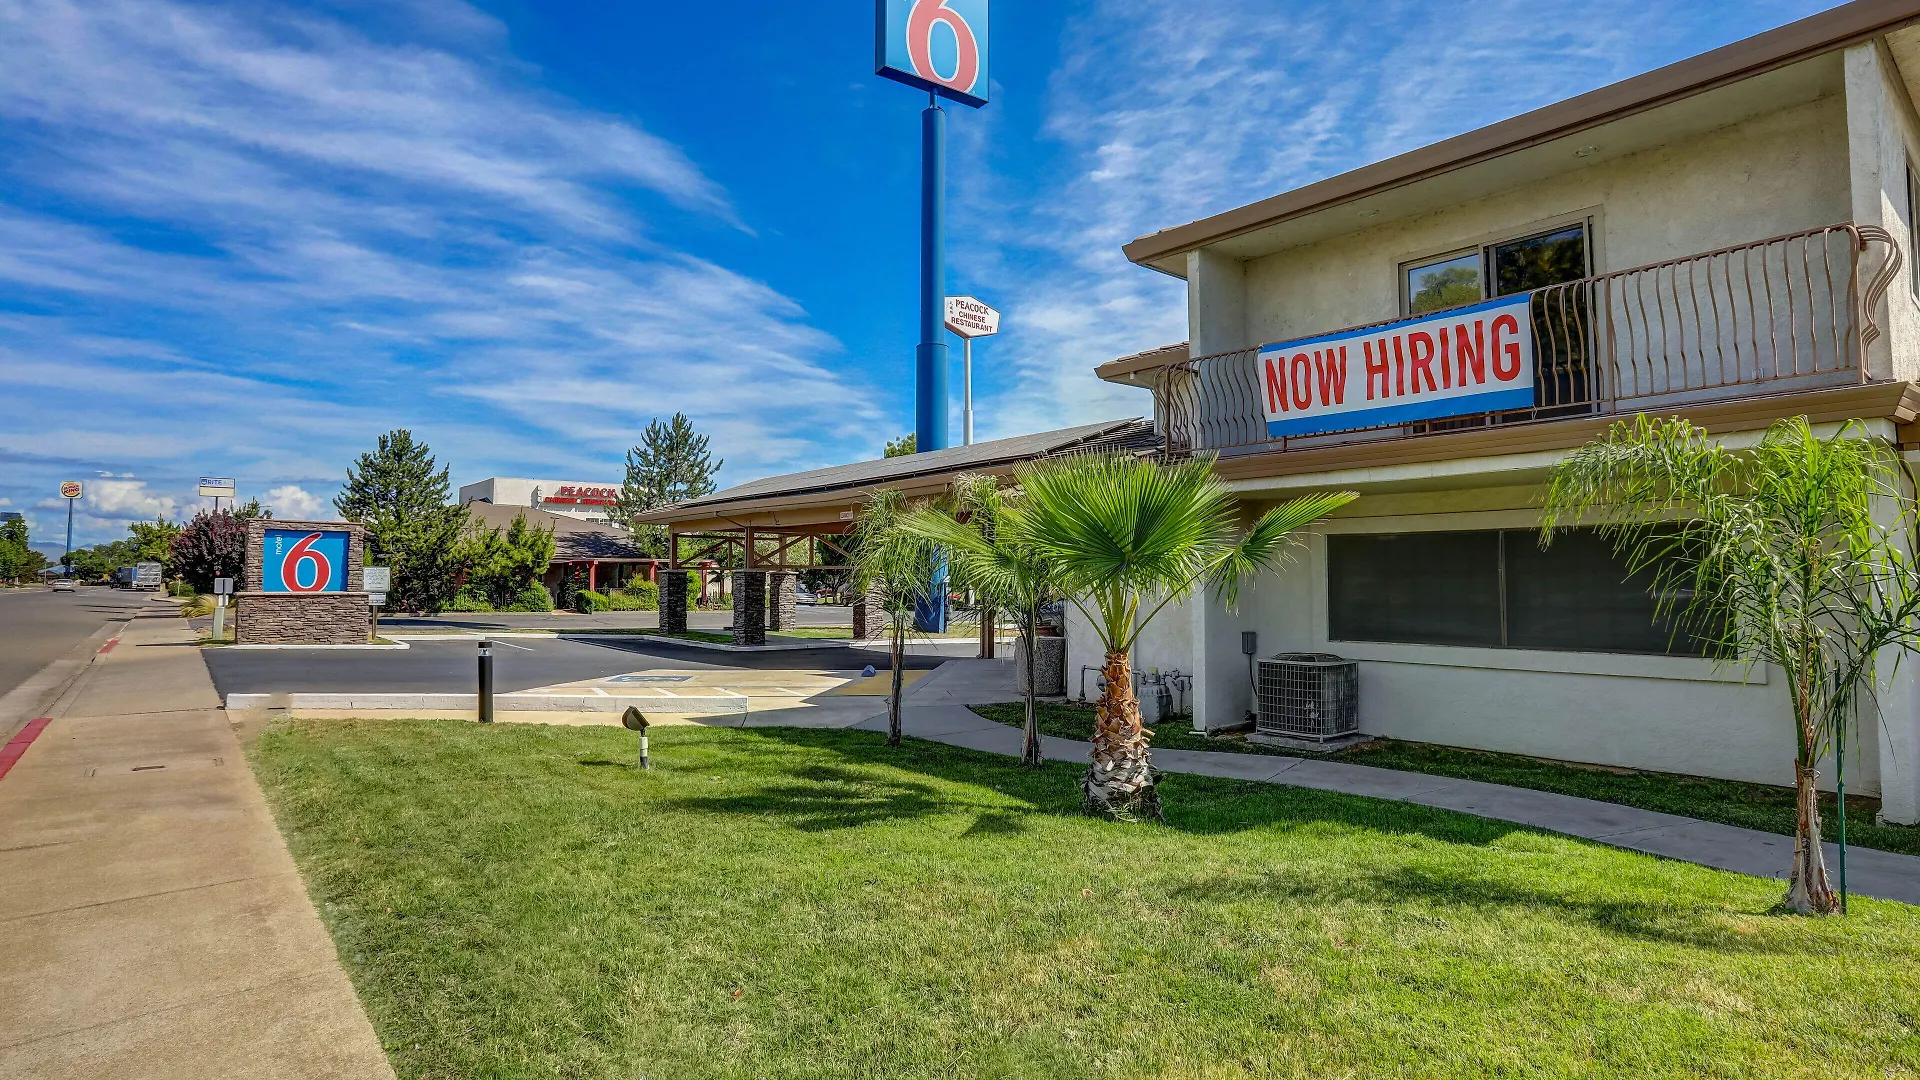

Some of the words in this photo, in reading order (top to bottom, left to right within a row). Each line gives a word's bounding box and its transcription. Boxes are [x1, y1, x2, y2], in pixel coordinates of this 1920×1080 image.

[906, 0, 980, 93] 6
[955, 299, 989, 315] PEACOCK
[951, 317, 993, 332] RESTAURANT
[958, 311, 985, 323] CHINESE
[1265, 346, 1347, 413] NOW
[1363, 314, 1521, 400] HIRING
[560, 486, 617, 498] PEACOCK
[274, 534, 283, 555] motel
[281, 532, 331, 592] 6
